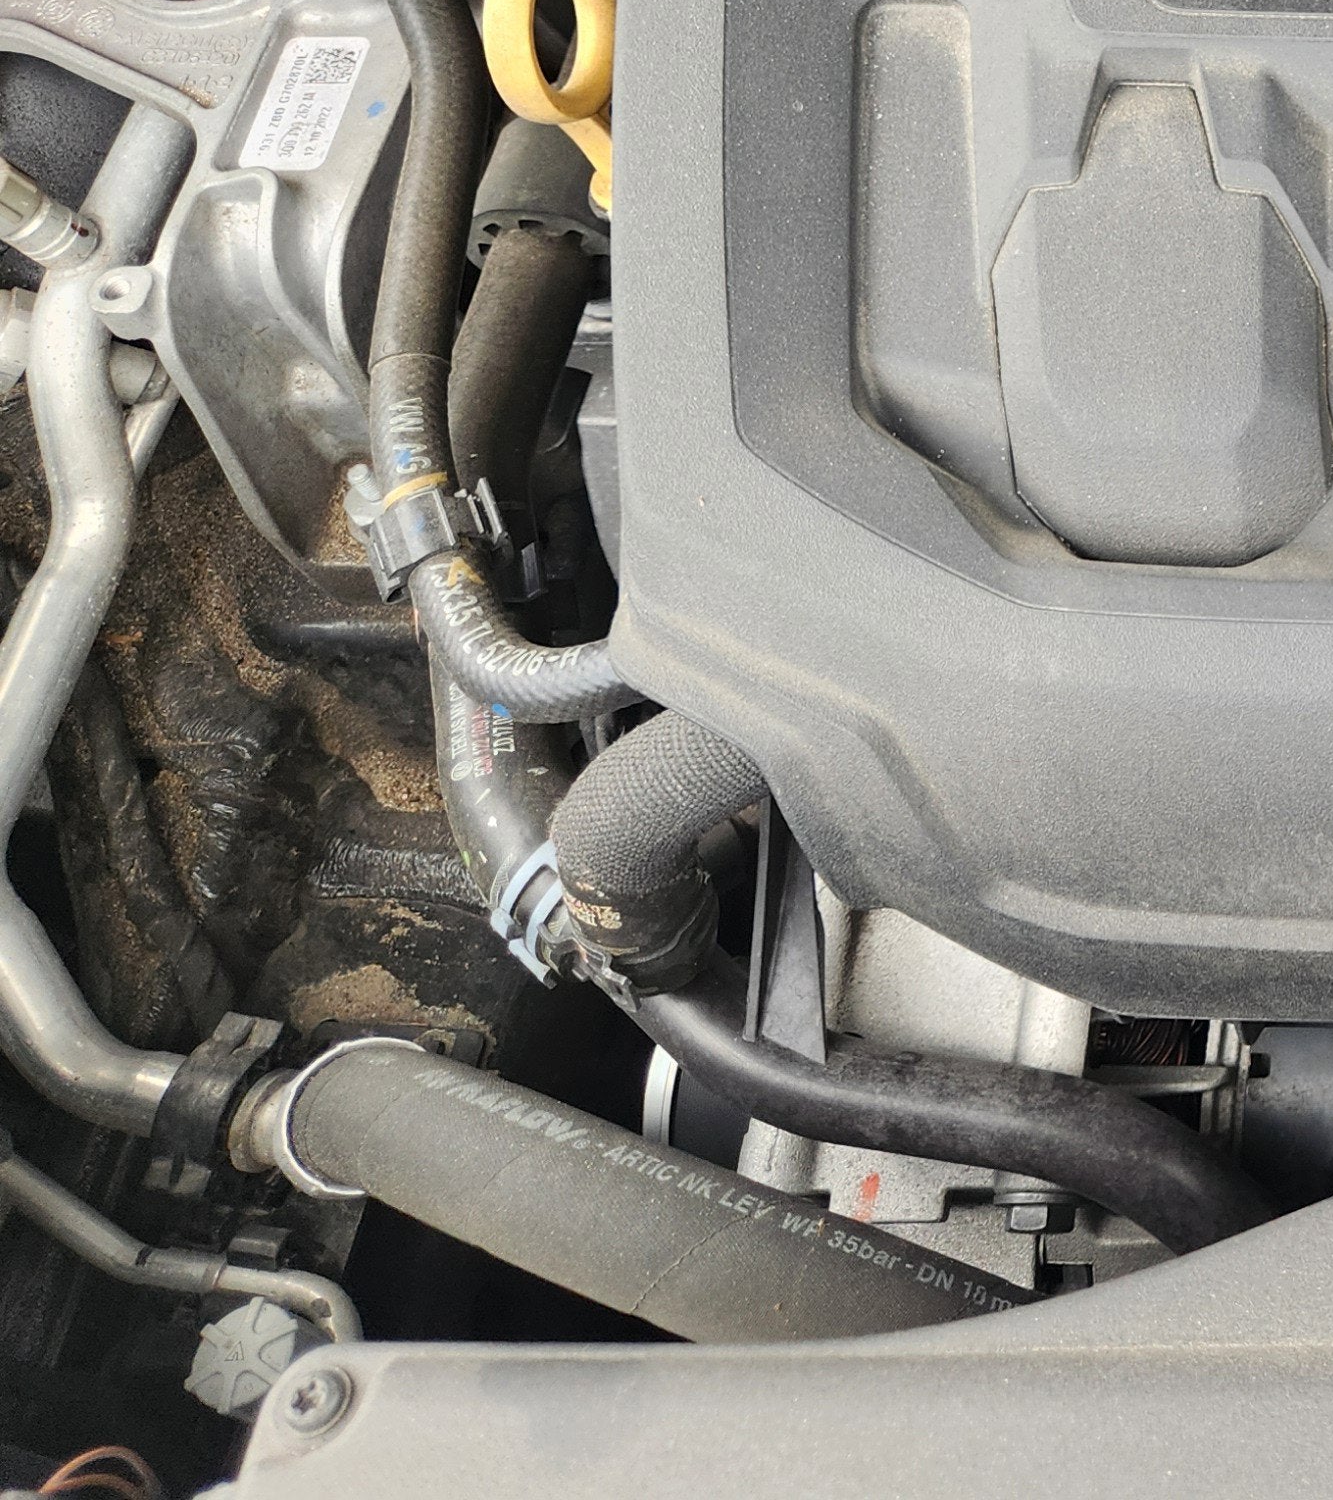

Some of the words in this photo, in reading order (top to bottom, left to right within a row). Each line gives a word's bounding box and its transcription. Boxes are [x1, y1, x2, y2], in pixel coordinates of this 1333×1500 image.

[388, 396, 425, 433] VW
[603, 1145, 680, 1181] ARTIC
[677, 1172, 712, 1199] NK
[718, 1187, 776, 1221] LEV
[827, 1228, 903, 1271] 35bar
[915, 1262, 955, 1293] DN
